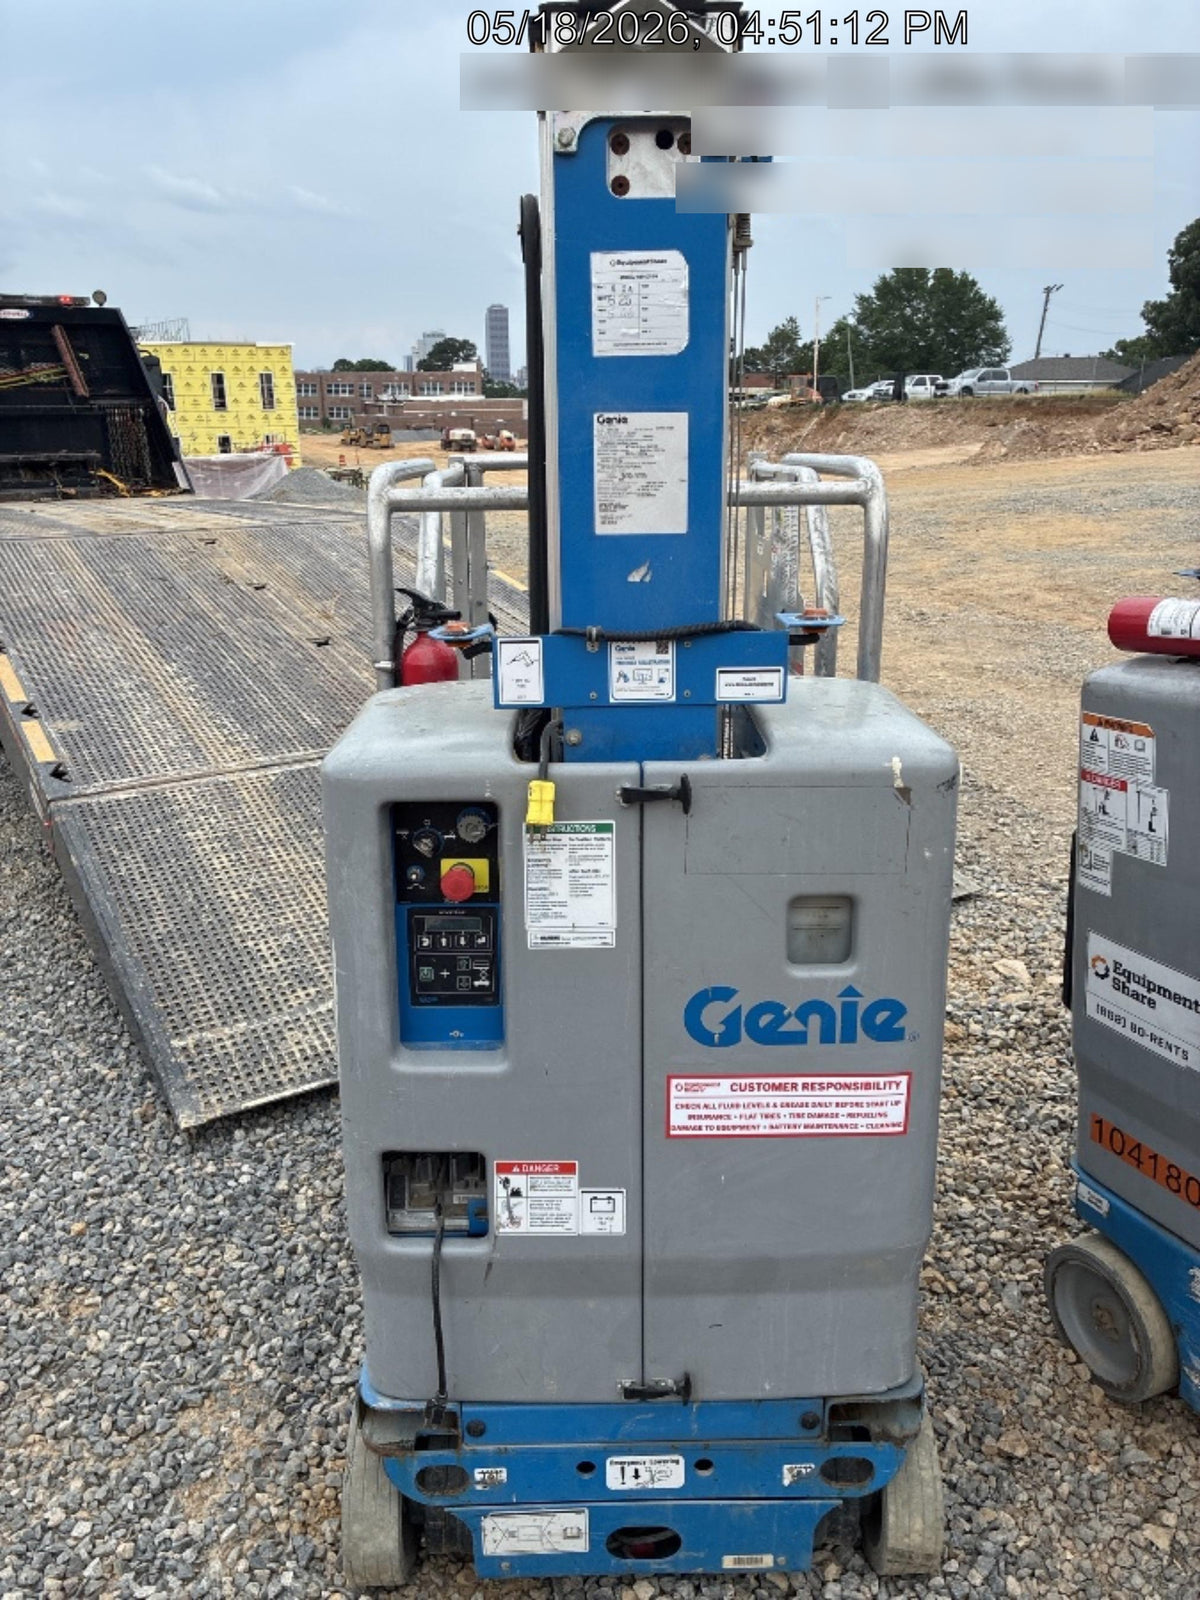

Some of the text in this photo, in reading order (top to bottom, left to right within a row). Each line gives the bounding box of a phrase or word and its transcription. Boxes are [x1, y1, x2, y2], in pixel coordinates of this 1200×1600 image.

[597, 414, 628, 425] Genie
[1112, 959, 1200, 1014] Equipment
[1112, 976, 1157, 1010] Share
[684, 985, 908, 1048] Genie
[730, 1080, 902, 1092] CUSTOMER RESPONSIBILITY
[866, 1100, 889, 1108] START
[846, 1111, 888, 1119] REFUELING
[671, 1124, 703, 1132] DAMAGE
[865, 1122, 902, 1130] CLEANING
[1094, 1118, 1200, 1206] 104180
[522, 1164, 561, 1173] DANGER
